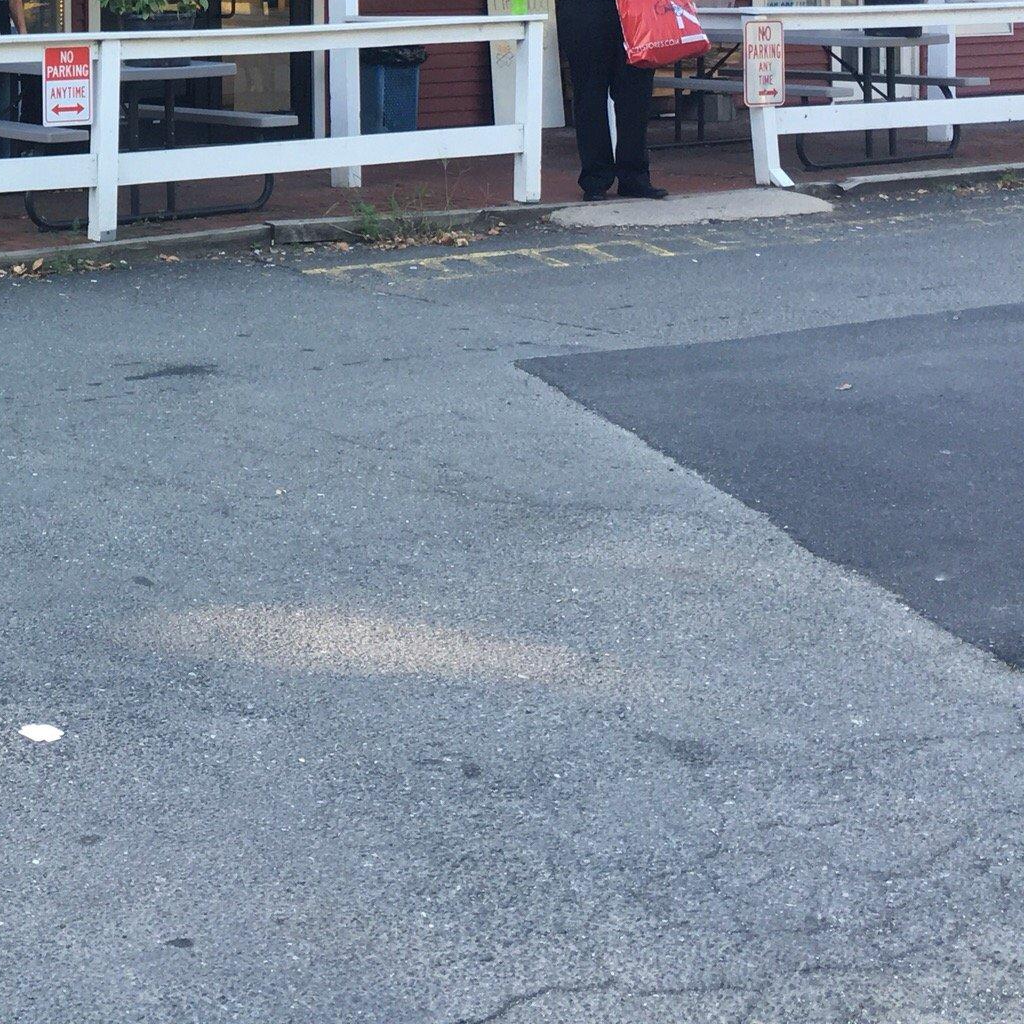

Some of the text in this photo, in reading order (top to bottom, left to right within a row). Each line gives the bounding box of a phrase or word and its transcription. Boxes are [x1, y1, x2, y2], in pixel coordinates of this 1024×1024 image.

[758, 25, 771, 42] NO
[60, 50, 74, 64] NO
[748, 43, 781, 60] PARKING
[47, 64, 89, 79] PARKING
[758, 62, 772, 73] ANY
[759, 75, 773, 86] TIME
[51, 85, 86, 99] ANYTIME
